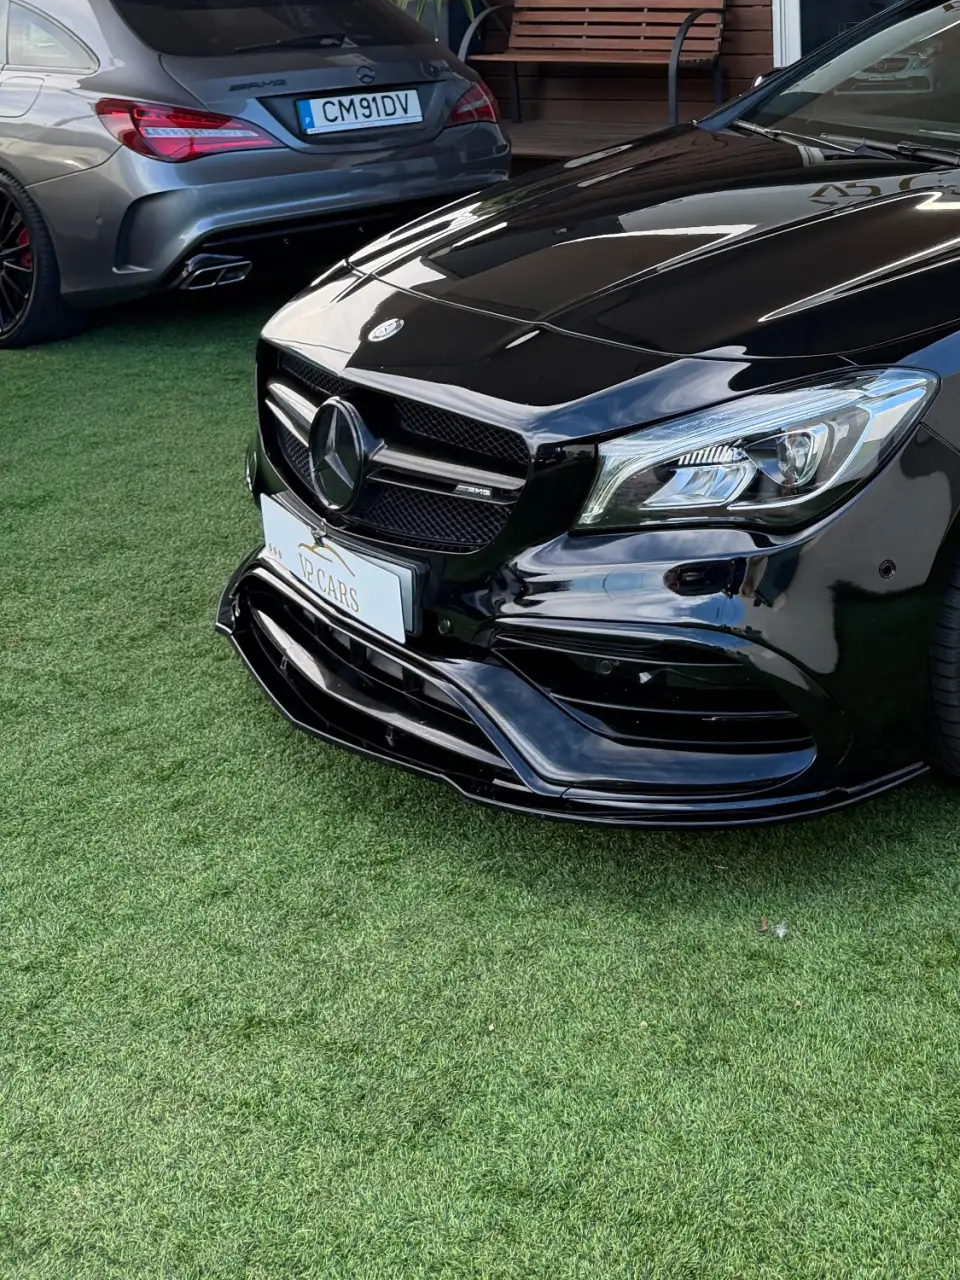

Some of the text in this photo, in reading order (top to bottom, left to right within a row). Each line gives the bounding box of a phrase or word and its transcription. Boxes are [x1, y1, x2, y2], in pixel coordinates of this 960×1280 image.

[322, 93, 408, 123] CM91DV
[298, 552, 360, 613] VP CARS
